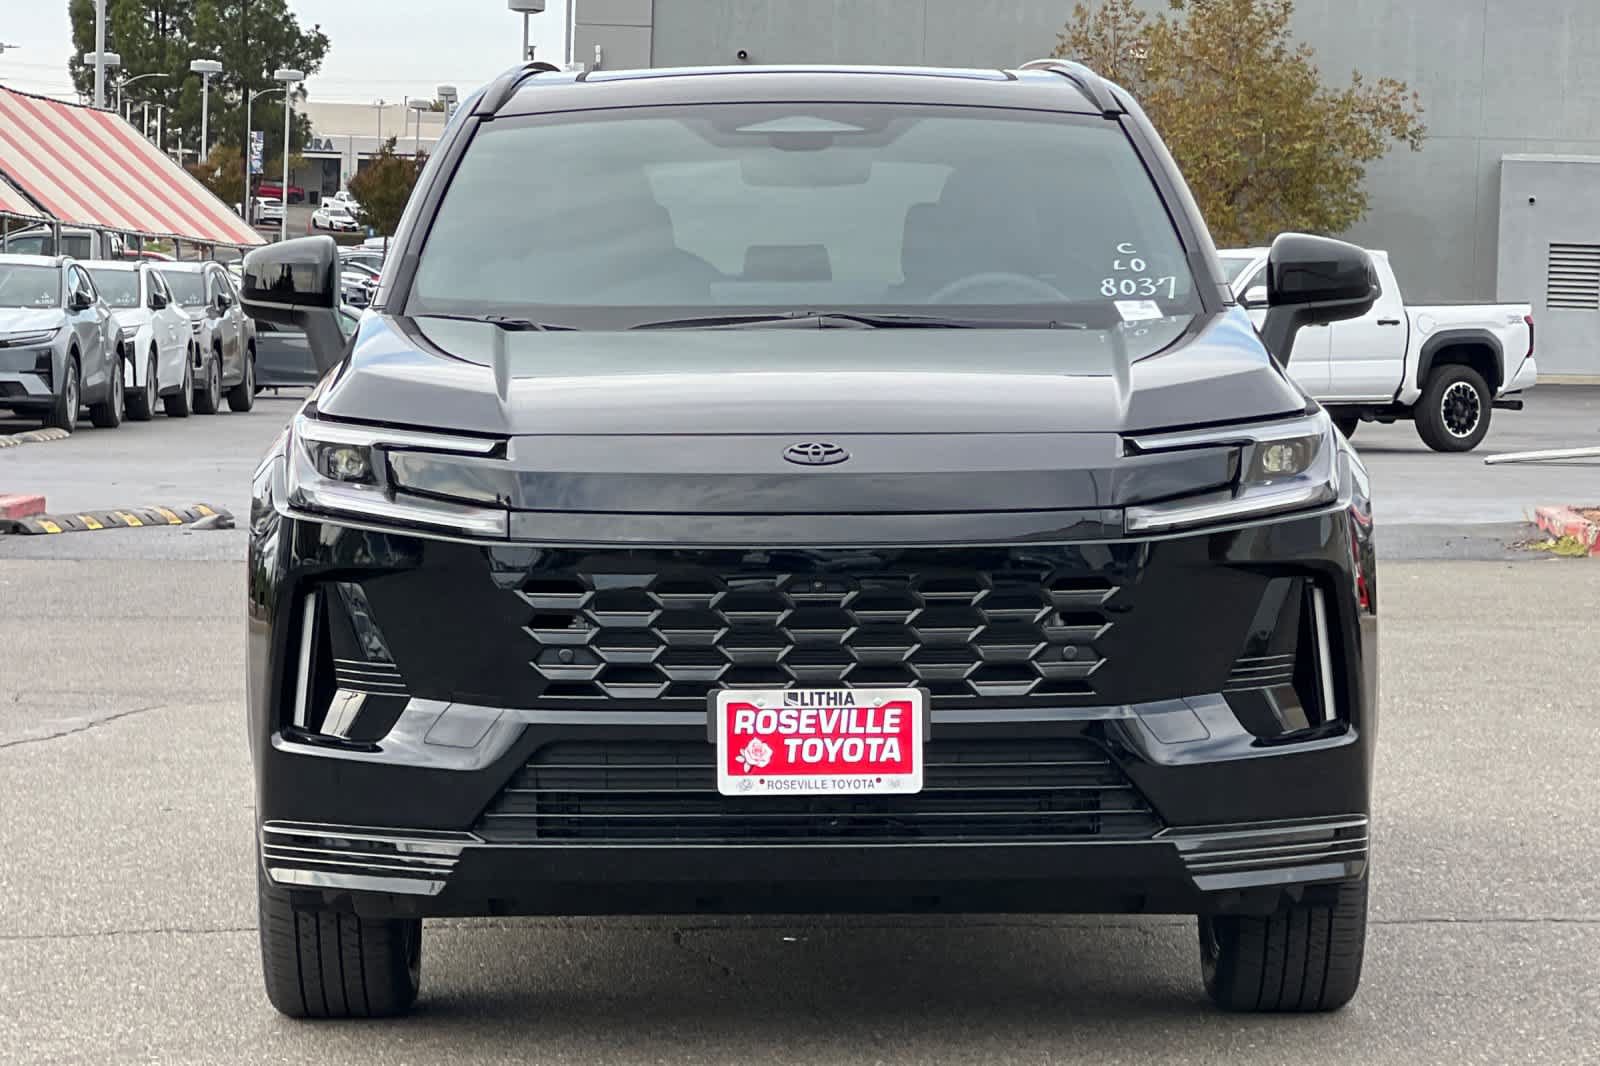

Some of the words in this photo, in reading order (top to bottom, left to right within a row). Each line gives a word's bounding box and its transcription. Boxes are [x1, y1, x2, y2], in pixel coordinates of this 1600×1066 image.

[1100, 276, 1176, 299] 8037
[800, 692, 855, 706] LITHIA
[734, 709, 902, 735] ROSEVILLE
[784, 738, 902, 763] TOYOTA
[767, 780, 828, 790] ROSEVILLE
[831, 778, 875, 789] TOYOTA
